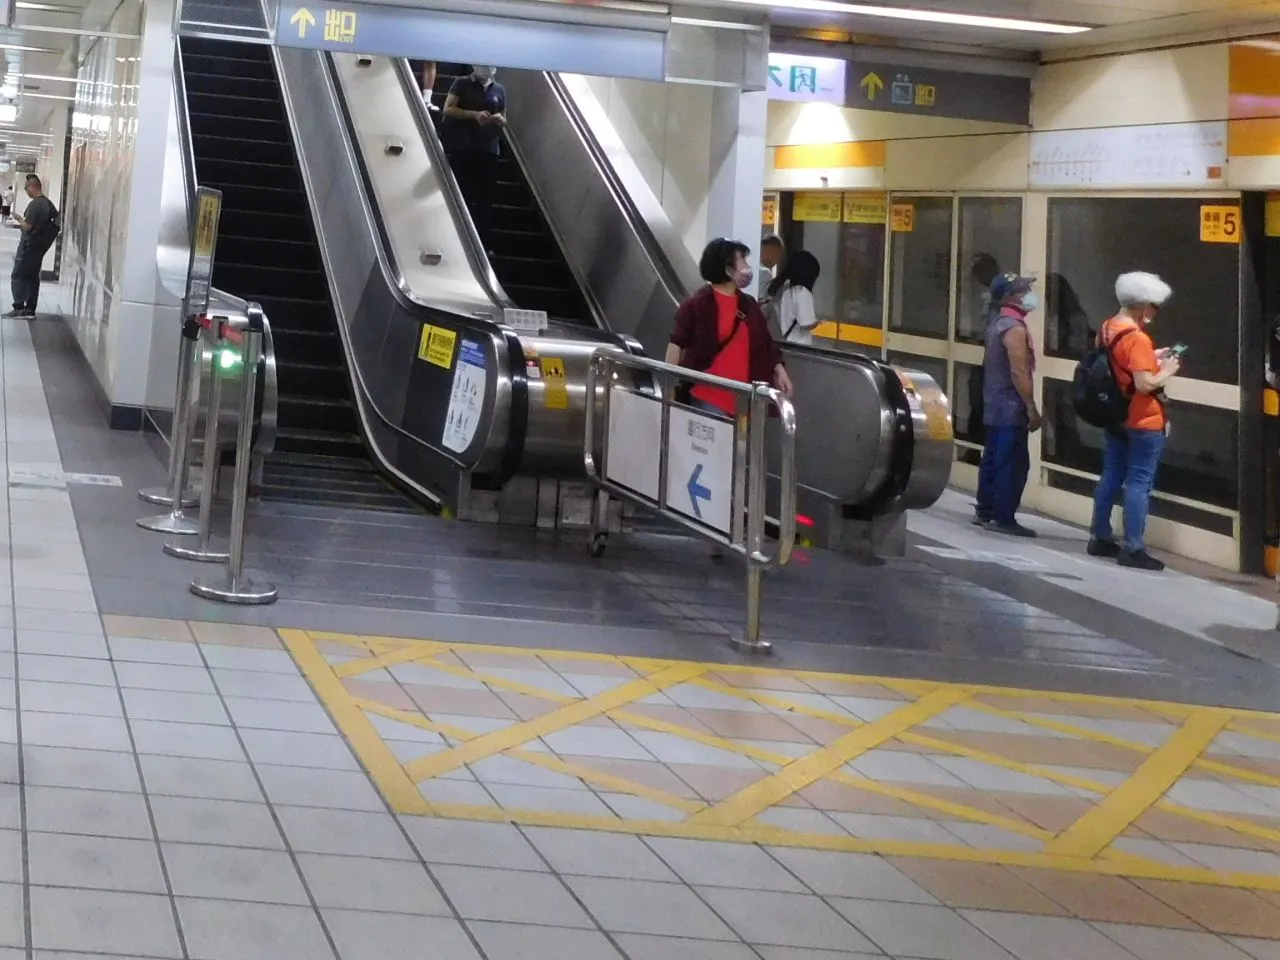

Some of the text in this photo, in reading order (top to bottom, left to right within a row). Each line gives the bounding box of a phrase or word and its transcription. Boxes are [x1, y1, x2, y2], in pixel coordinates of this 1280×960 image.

[324, 8, 356, 42] 出口
[914, 84, 936, 106] 出口
[1223, 212, 1236, 236] 5
